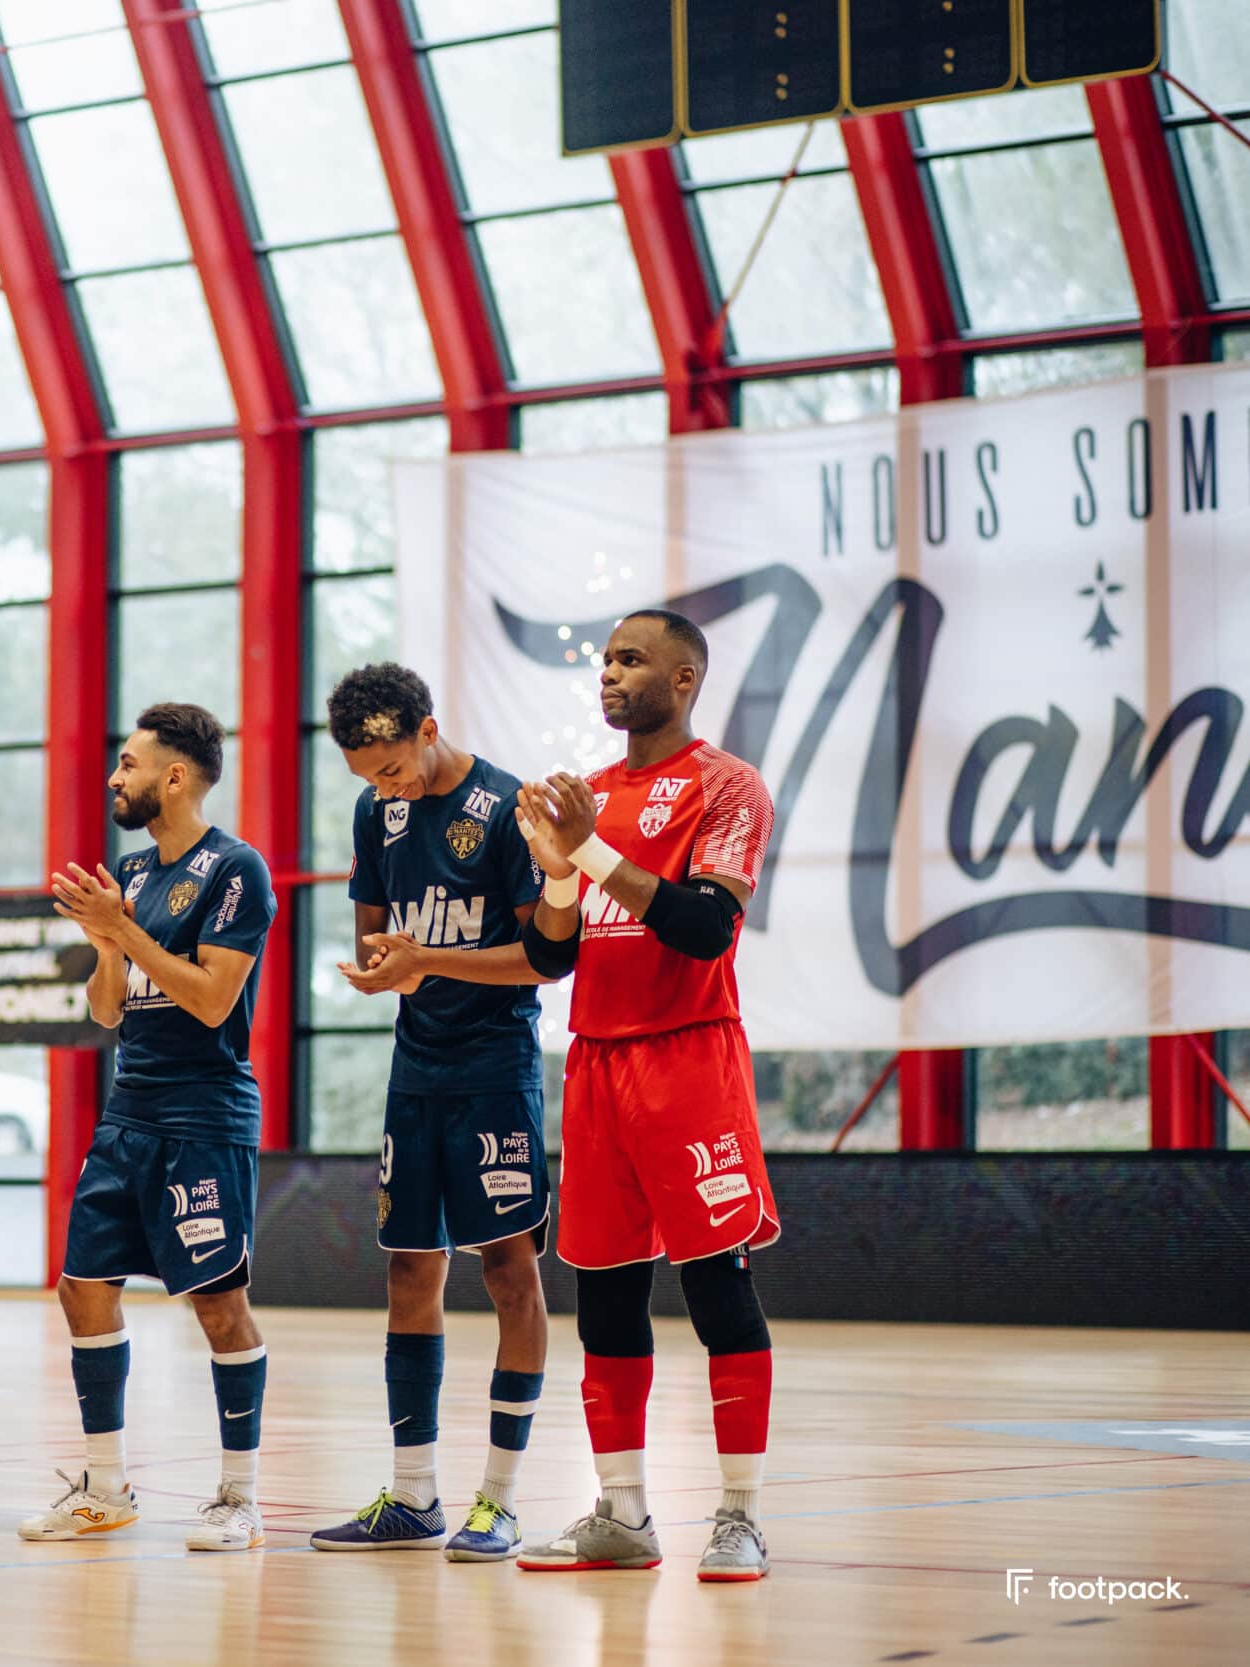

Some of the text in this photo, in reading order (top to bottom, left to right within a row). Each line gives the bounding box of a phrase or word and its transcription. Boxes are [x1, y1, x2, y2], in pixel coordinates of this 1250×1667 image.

[820, 409, 1250, 557] NOUS SOM
[492, 561, 1250, 998] Nan
[503, 1138, 529, 1148] PAYS
[713, 1137, 739, 1155] PAYS
[500, 1154, 531, 1164] LOIRE
[714, 1153, 744, 1171] LOIRE
[192, 1184, 218, 1198] PAYS
[489, 1181, 527, 1190] Atlantique
[704, 1180, 724, 1191] Loire
[190, 1199, 221, 1214] LOIRE
[182, 1223, 199, 1232] Loire
